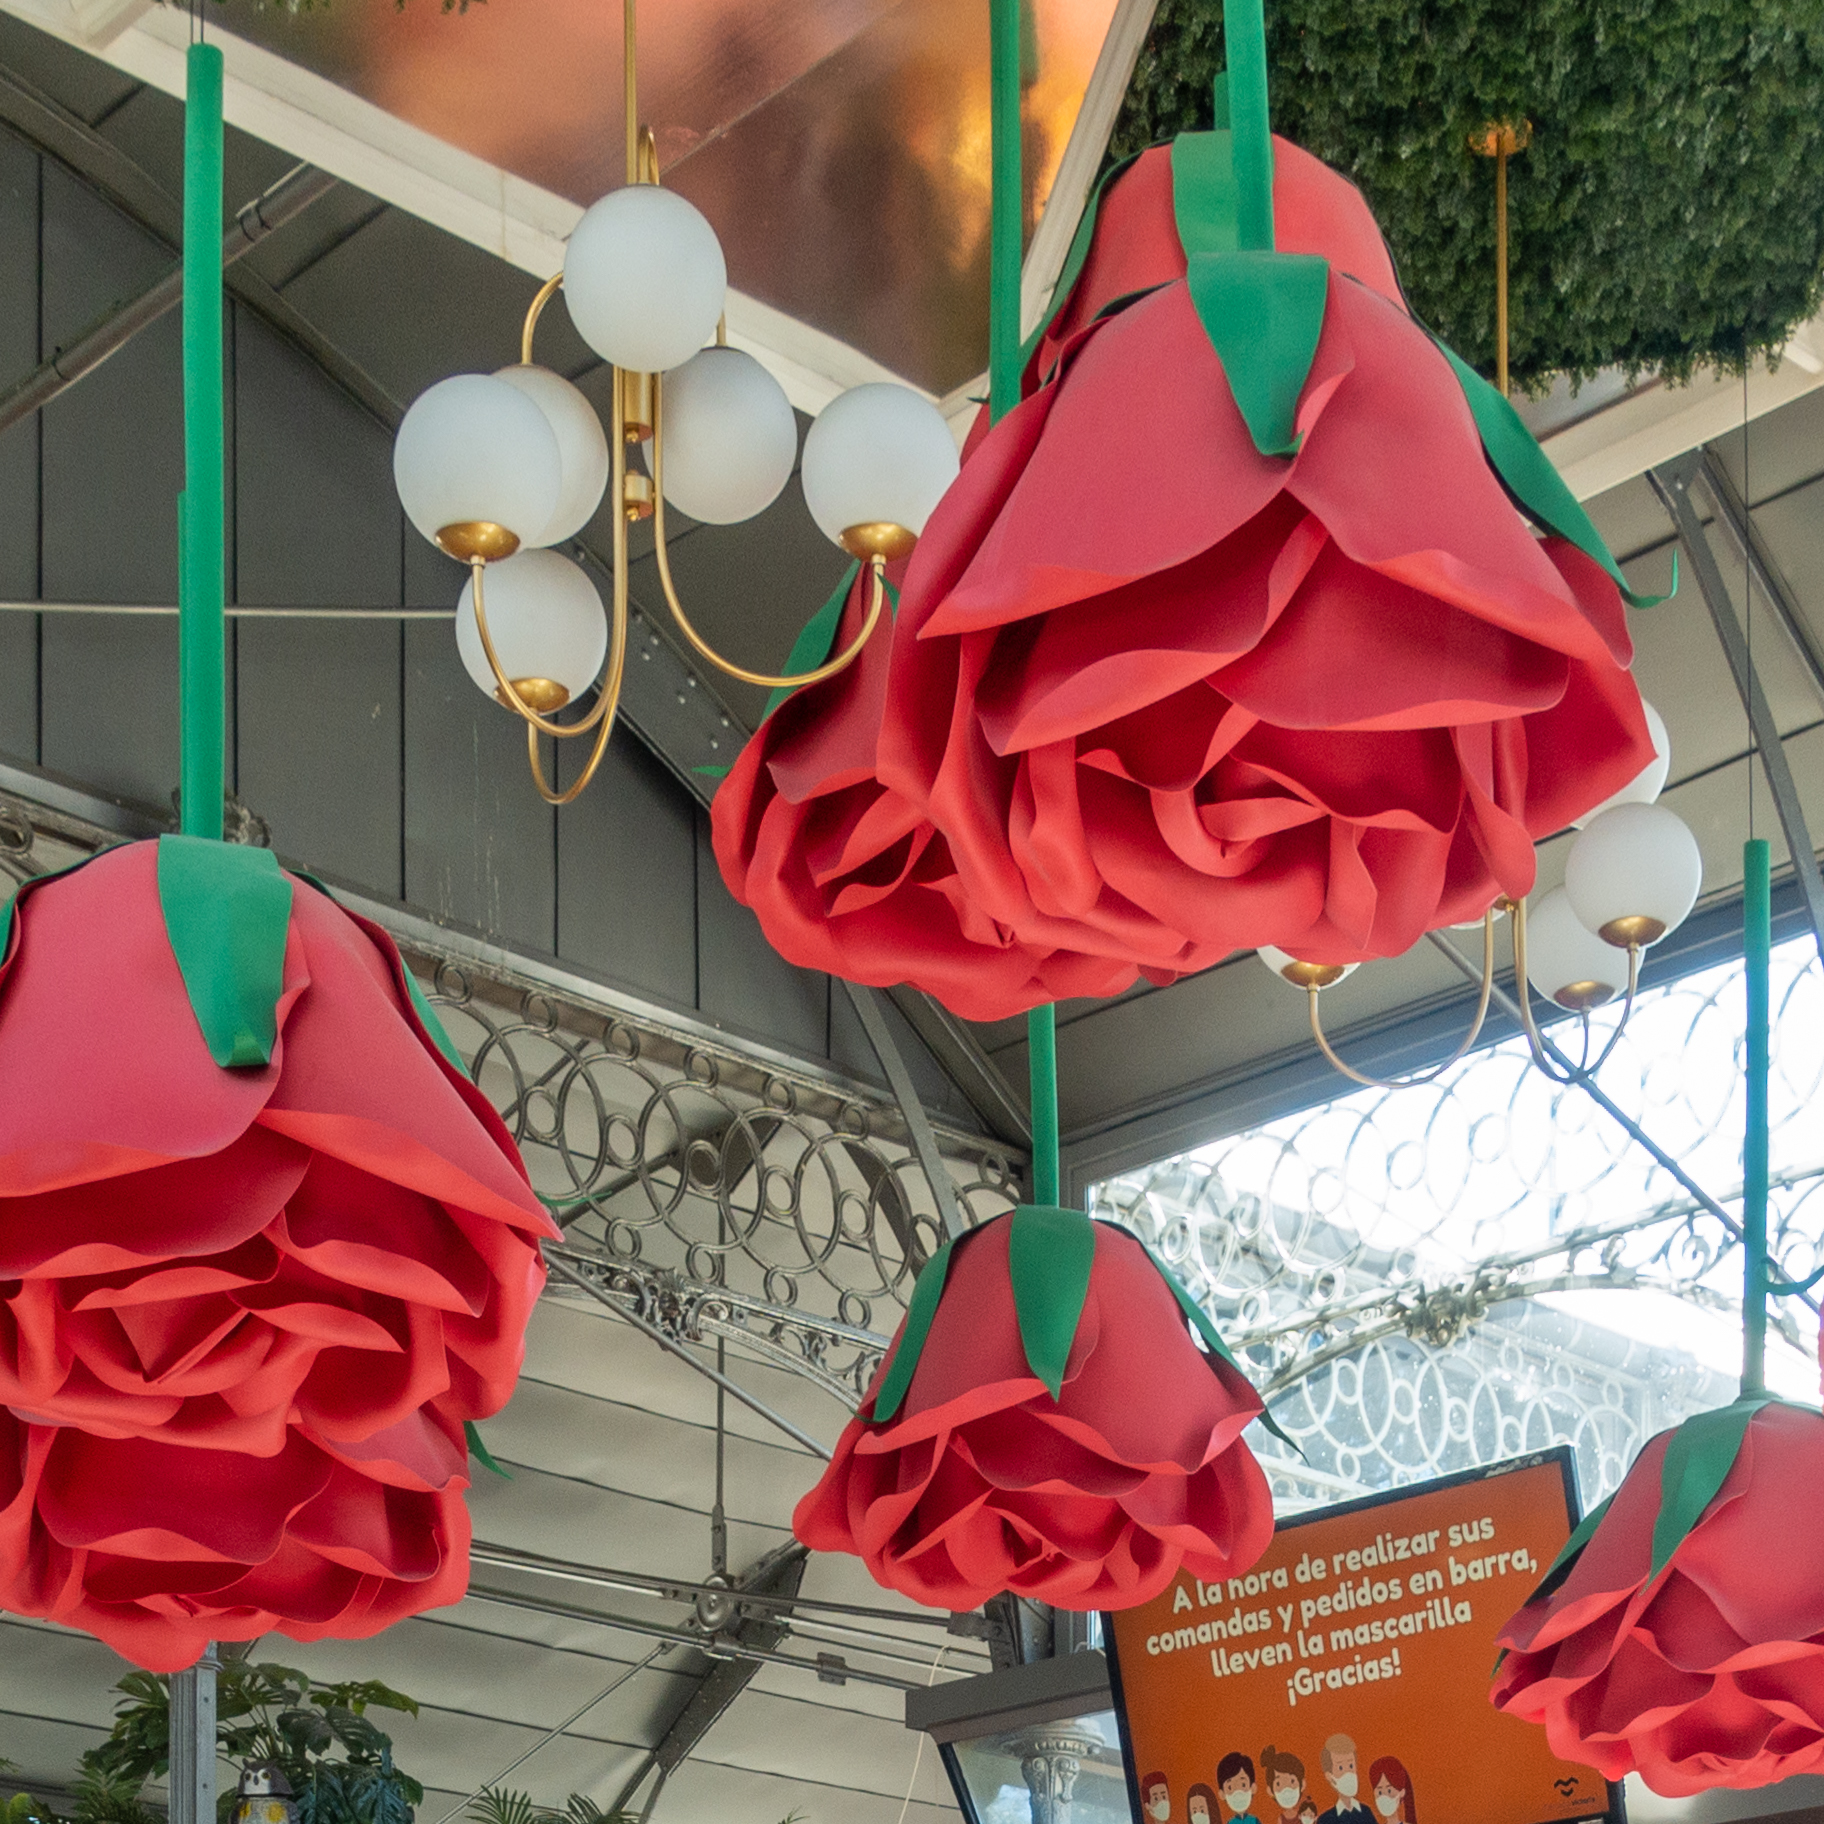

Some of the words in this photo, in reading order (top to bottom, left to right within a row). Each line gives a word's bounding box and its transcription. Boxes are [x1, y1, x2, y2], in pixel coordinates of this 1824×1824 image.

[1146, 1607, 1272, 1655] comandas
[1278, 1604, 1294, 1632] y
[1301, 1577, 1403, 1628] pedidos
[1409, 1568, 1443, 1593] en
[1449, 1547, 1537, 1585] barra,
[1173, 1586, 1193, 1613] A
[1197, 1580, 1223, 1607] la
[1295, 1553, 1327, 1583] de
[1333, 1528, 1440, 1575] realizar
[1448, 1517, 1495, 1547] sus
[1211, 1640, 1293, 1677] lleven
[1297, 1630, 1324, 1658] la
[1330, 1597, 1472, 1652] mascarilla
[1288, 1648, 1402, 1706] ¡Gracias!
